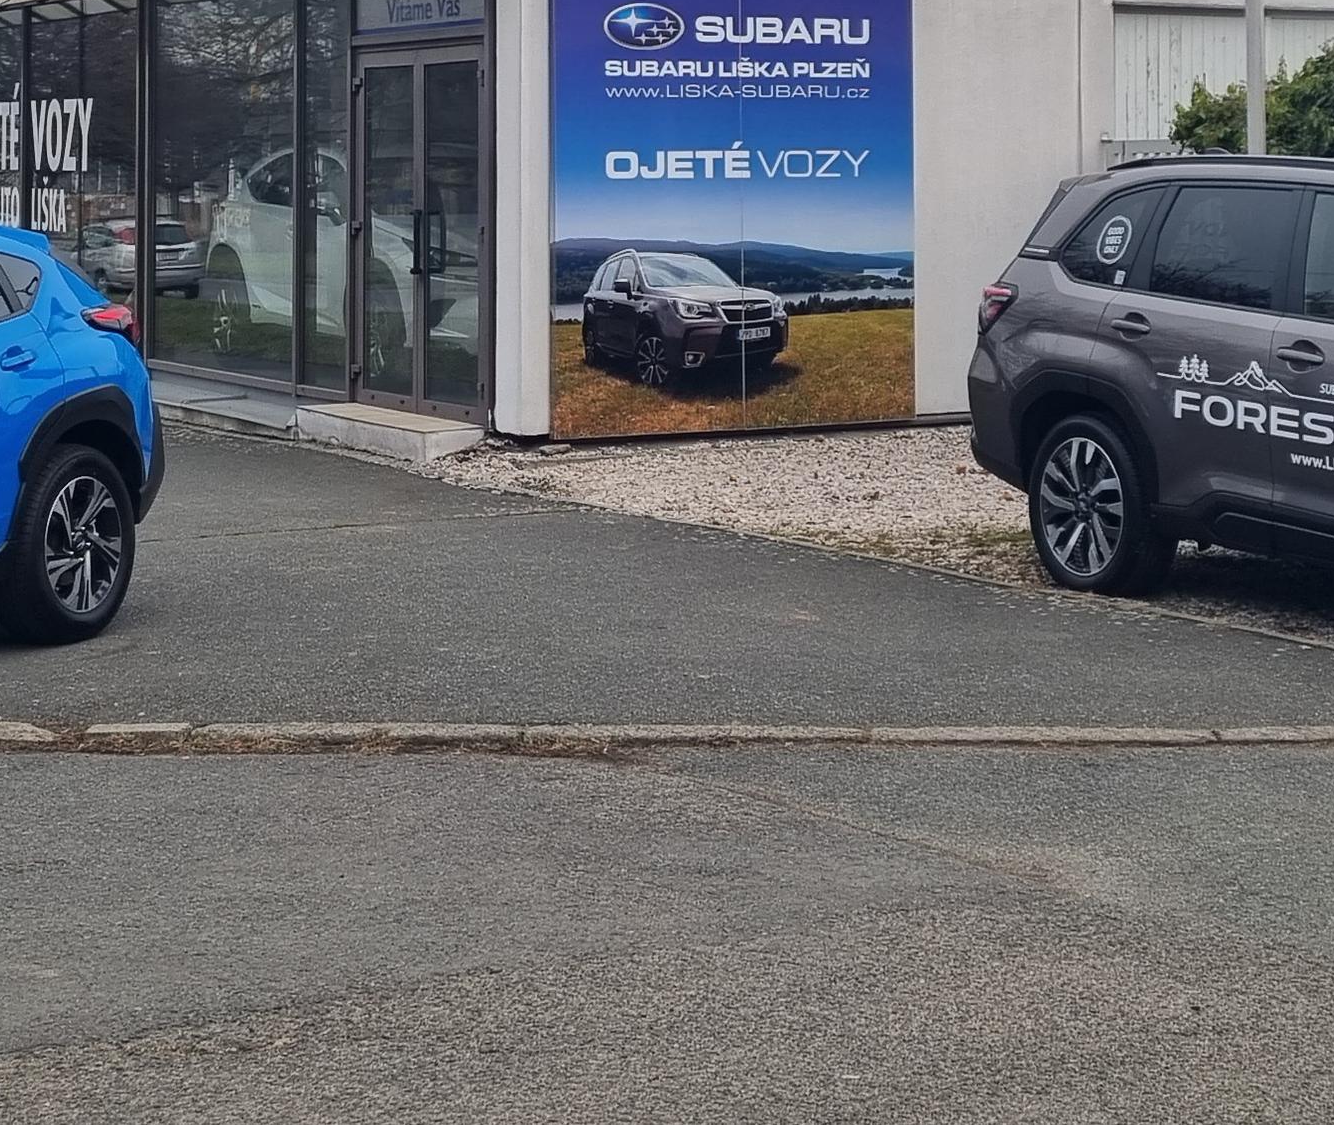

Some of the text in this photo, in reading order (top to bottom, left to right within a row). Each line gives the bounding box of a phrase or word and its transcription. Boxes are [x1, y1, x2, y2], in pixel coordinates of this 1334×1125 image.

[694, 15, 871, 45] SUBARU
[604, 56, 871, 79] SUBARU LIŠKA PLZEŇ
[605, 83, 871, 99] www.LISKA-SUBARU.cz
[30, 97, 95, 172] VOZY
[604, 140, 871, 179] OJETÉ VOZY
[30, 175, 67, 234] LIŠKA
